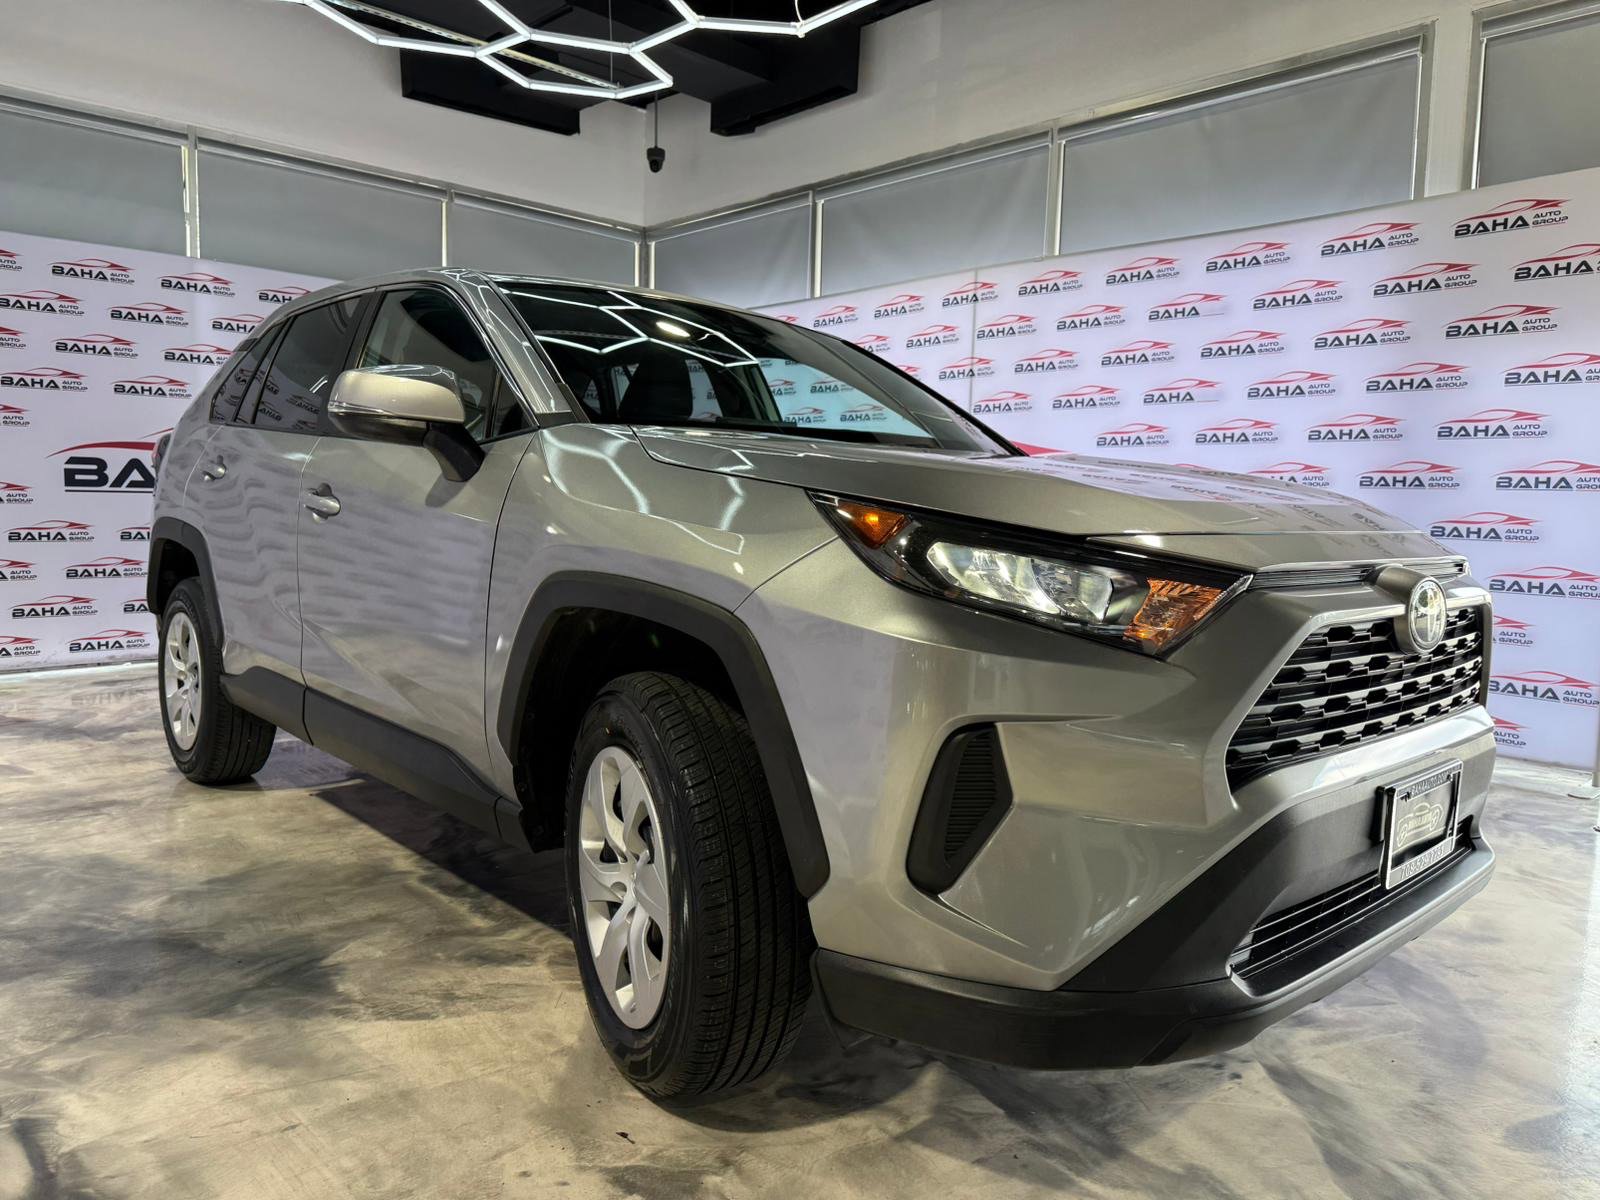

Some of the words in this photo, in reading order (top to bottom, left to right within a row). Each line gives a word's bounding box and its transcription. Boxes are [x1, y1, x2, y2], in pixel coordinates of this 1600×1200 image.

[1455, 216, 1529, 236] BAHA
[1532, 216, 1568, 225] GROUP
[1321, 238, 1384, 256] BAHA
[1388, 238, 1419, 246] GROUP
[1206, 256, 1261, 272] BAHA
[1514, 260, 1594, 280] BAHA
[52, 266, 108, 280] BAHA
[1106, 270, 1154, 284] BAHA
[161, 279, 211, 293] BAHA
[1018, 283, 1060, 296] BAHA
[1374, 278, 1441, 296] BAHA
[1444, 280, 1477, 288] GROUP
[259, 292, 292, 303] BAH
[942, 294, 978, 306] BAHA
[1253, 294, 1312, 309] BAHA
[0, 298, 57, 312] BAHA
[111, 310, 163, 323] BAHA
[874, 306, 908, 318] BAHA
[1149, 307, 1199, 320] BAHA
[814, 316, 842, 328] BAHA
[1057, 318, 1101, 330] BAHA
[977, 327, 1015, 339] BAHA
[1446, 321, 1519, 337] BAHA
[906, 336, 940, 348] BAHA
[1314, 334, 1378, 348] BAHA
[56, 342, 112, 355] BAHA
[1201, 344, 1256, 358] BAHA
[164, 352, 215, 364] BAHA
[1102, 354, 1148, 366] BAHA
[1015, 362, 1056, 372] BAHA
[939, 369, 975, 380] BAHA
[1504, 370, 1582, 384] BAHA
[1, 377, 59, 389] BAHA
[1366, 378, 1434, 392] BAHA
[114, 384, 167, 396] BAHA
[1248, 385, 1306, 398] BAHA
[1052, 398, 1097, 408] BAHA
[1144, 392, 1194, 404] BAHA
[974, 403, 1012, 413] BAHA
[1308, 428, 1370, 440] BAHA
[1438, 425, 1510, 437] BAHA
[1097, 436, 1144, 446] BAHA
[1196, 432, 1250, 443] BAHA
[64, 456, 154, 488] BA
[1360, 476, 1426, 488] BAHA
[1496, 477, 1572, 488] BAHA
[8, 532, 66, 541] BAHA
[120, 532, 150, 540] BA
[1430, 526, 1502, 540] BAHA
[66, 568, 122, 577] BAHA
[1489, 579, 1565, 596] BAHA
[12, 607, 70, 617] BAHA
[124, 604, 150, 612] BA
[70, 641, 124, 652] BAHA
[1489, 681, 1560, 700] BAHA
[1563, 697, 1600, 705] GROUP
